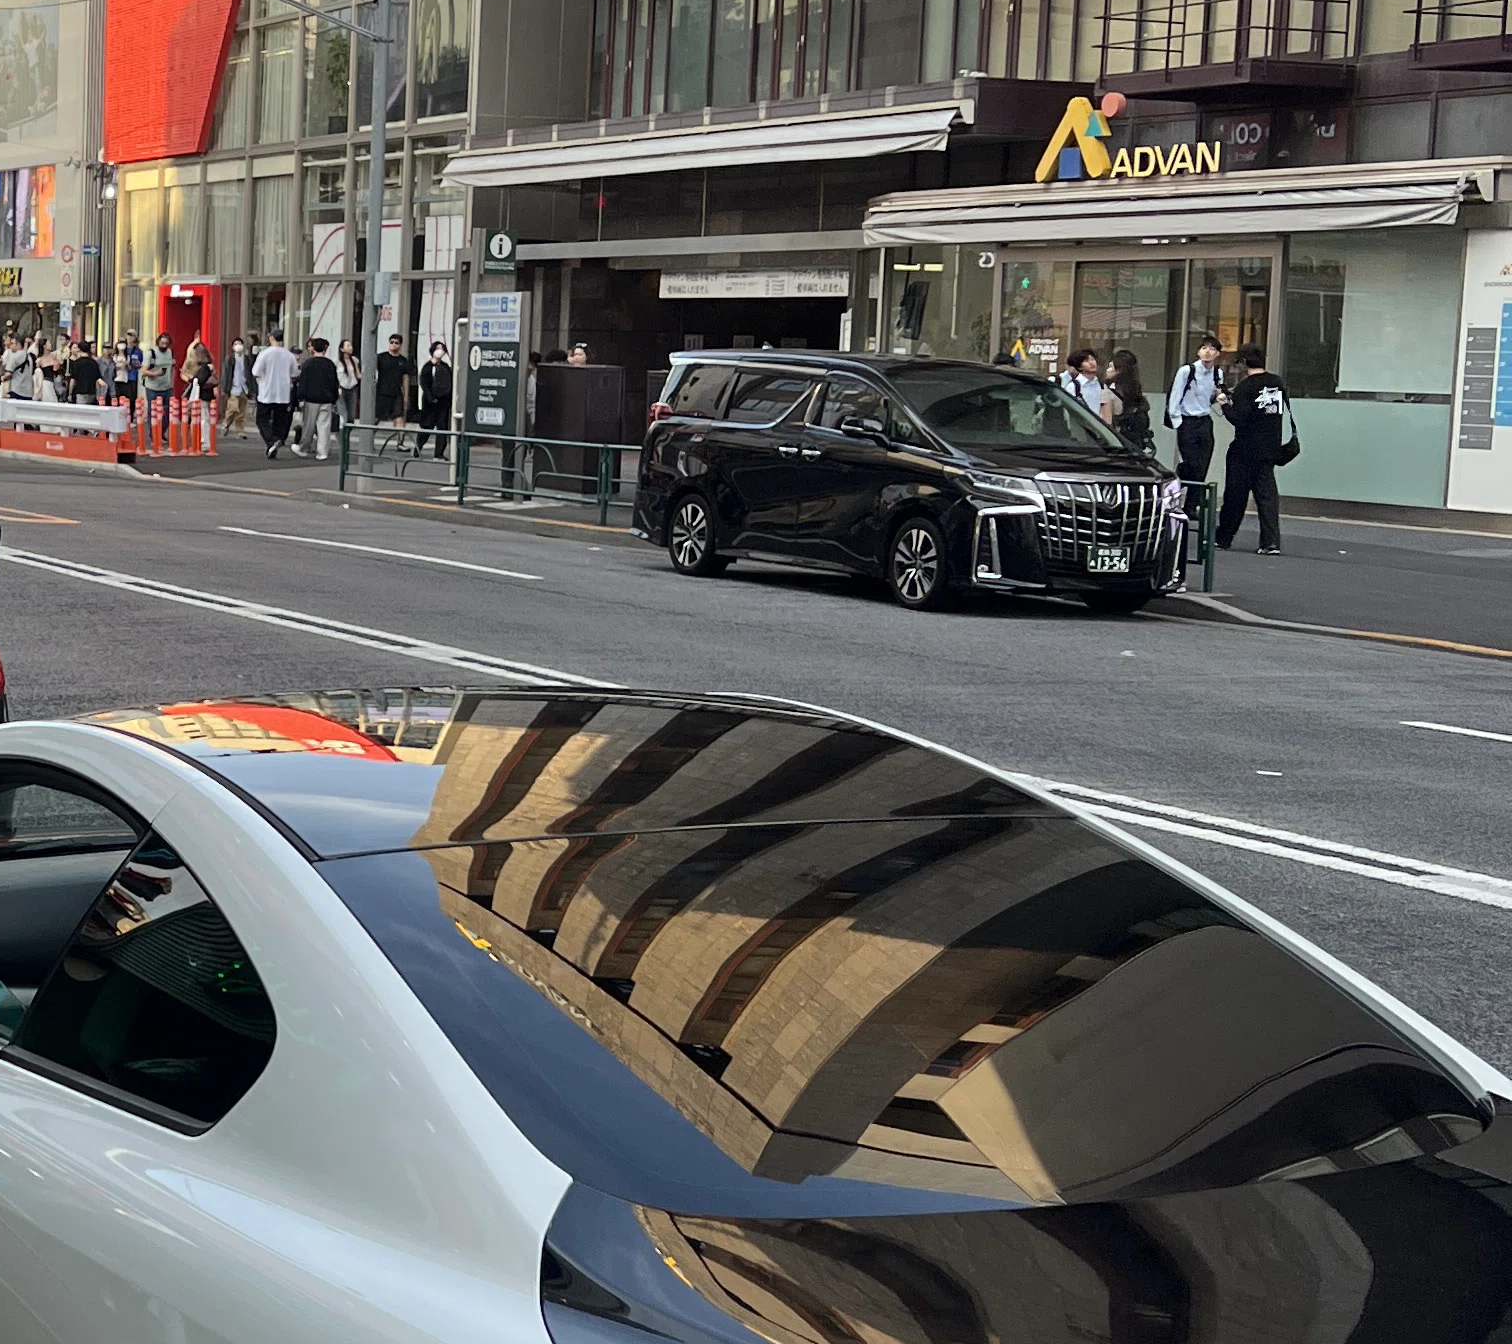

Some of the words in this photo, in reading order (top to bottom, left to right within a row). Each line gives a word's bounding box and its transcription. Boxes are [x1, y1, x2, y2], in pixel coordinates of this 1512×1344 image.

[1110, 141, 1221, 178] ADVAN
[1028, 344, 1059, 354] ADVAN
[1097, 556, 1127, 570] 13-56
